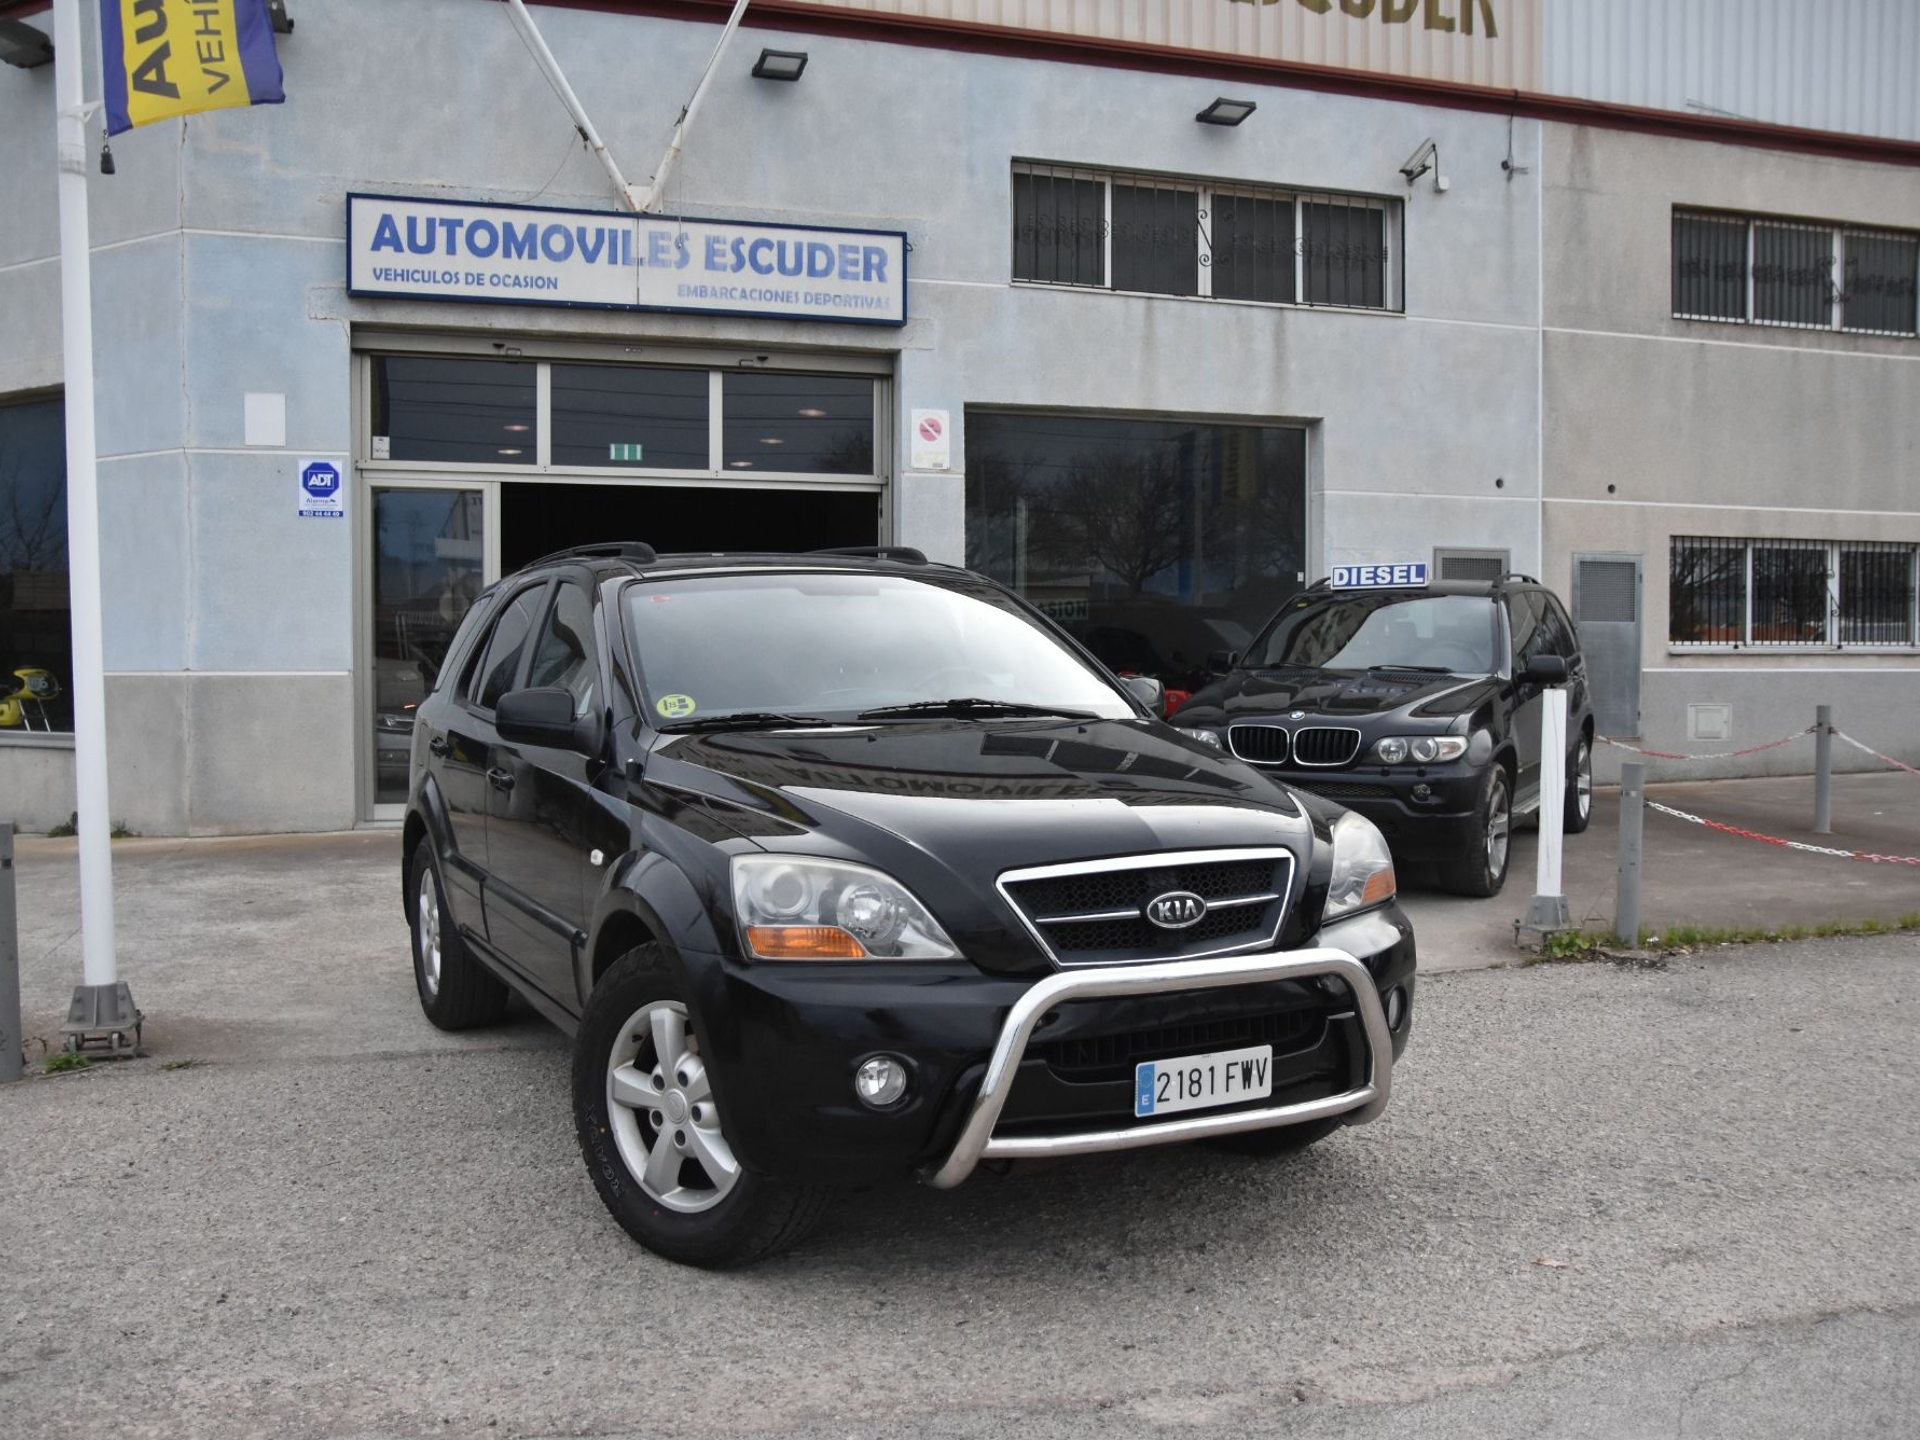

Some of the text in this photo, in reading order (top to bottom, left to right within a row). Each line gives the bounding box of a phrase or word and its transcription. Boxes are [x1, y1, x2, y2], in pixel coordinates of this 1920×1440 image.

[370, 213, 889, 283] AUTOMOVILES ESCUDER
[373, 267, 559, 290] VEHICULOS DE OCASION
[677, 284, 800, 304] EMBARCACIONES
[309, 473, 334, 487] ADT
[1333, 565, 1424, 586] DIESEL
[1156, 899, 1198, 922] KIA
[1156, 1057, 1268, 1103] 2181 FWV
[1141, 1094, 1150, 1105] E
